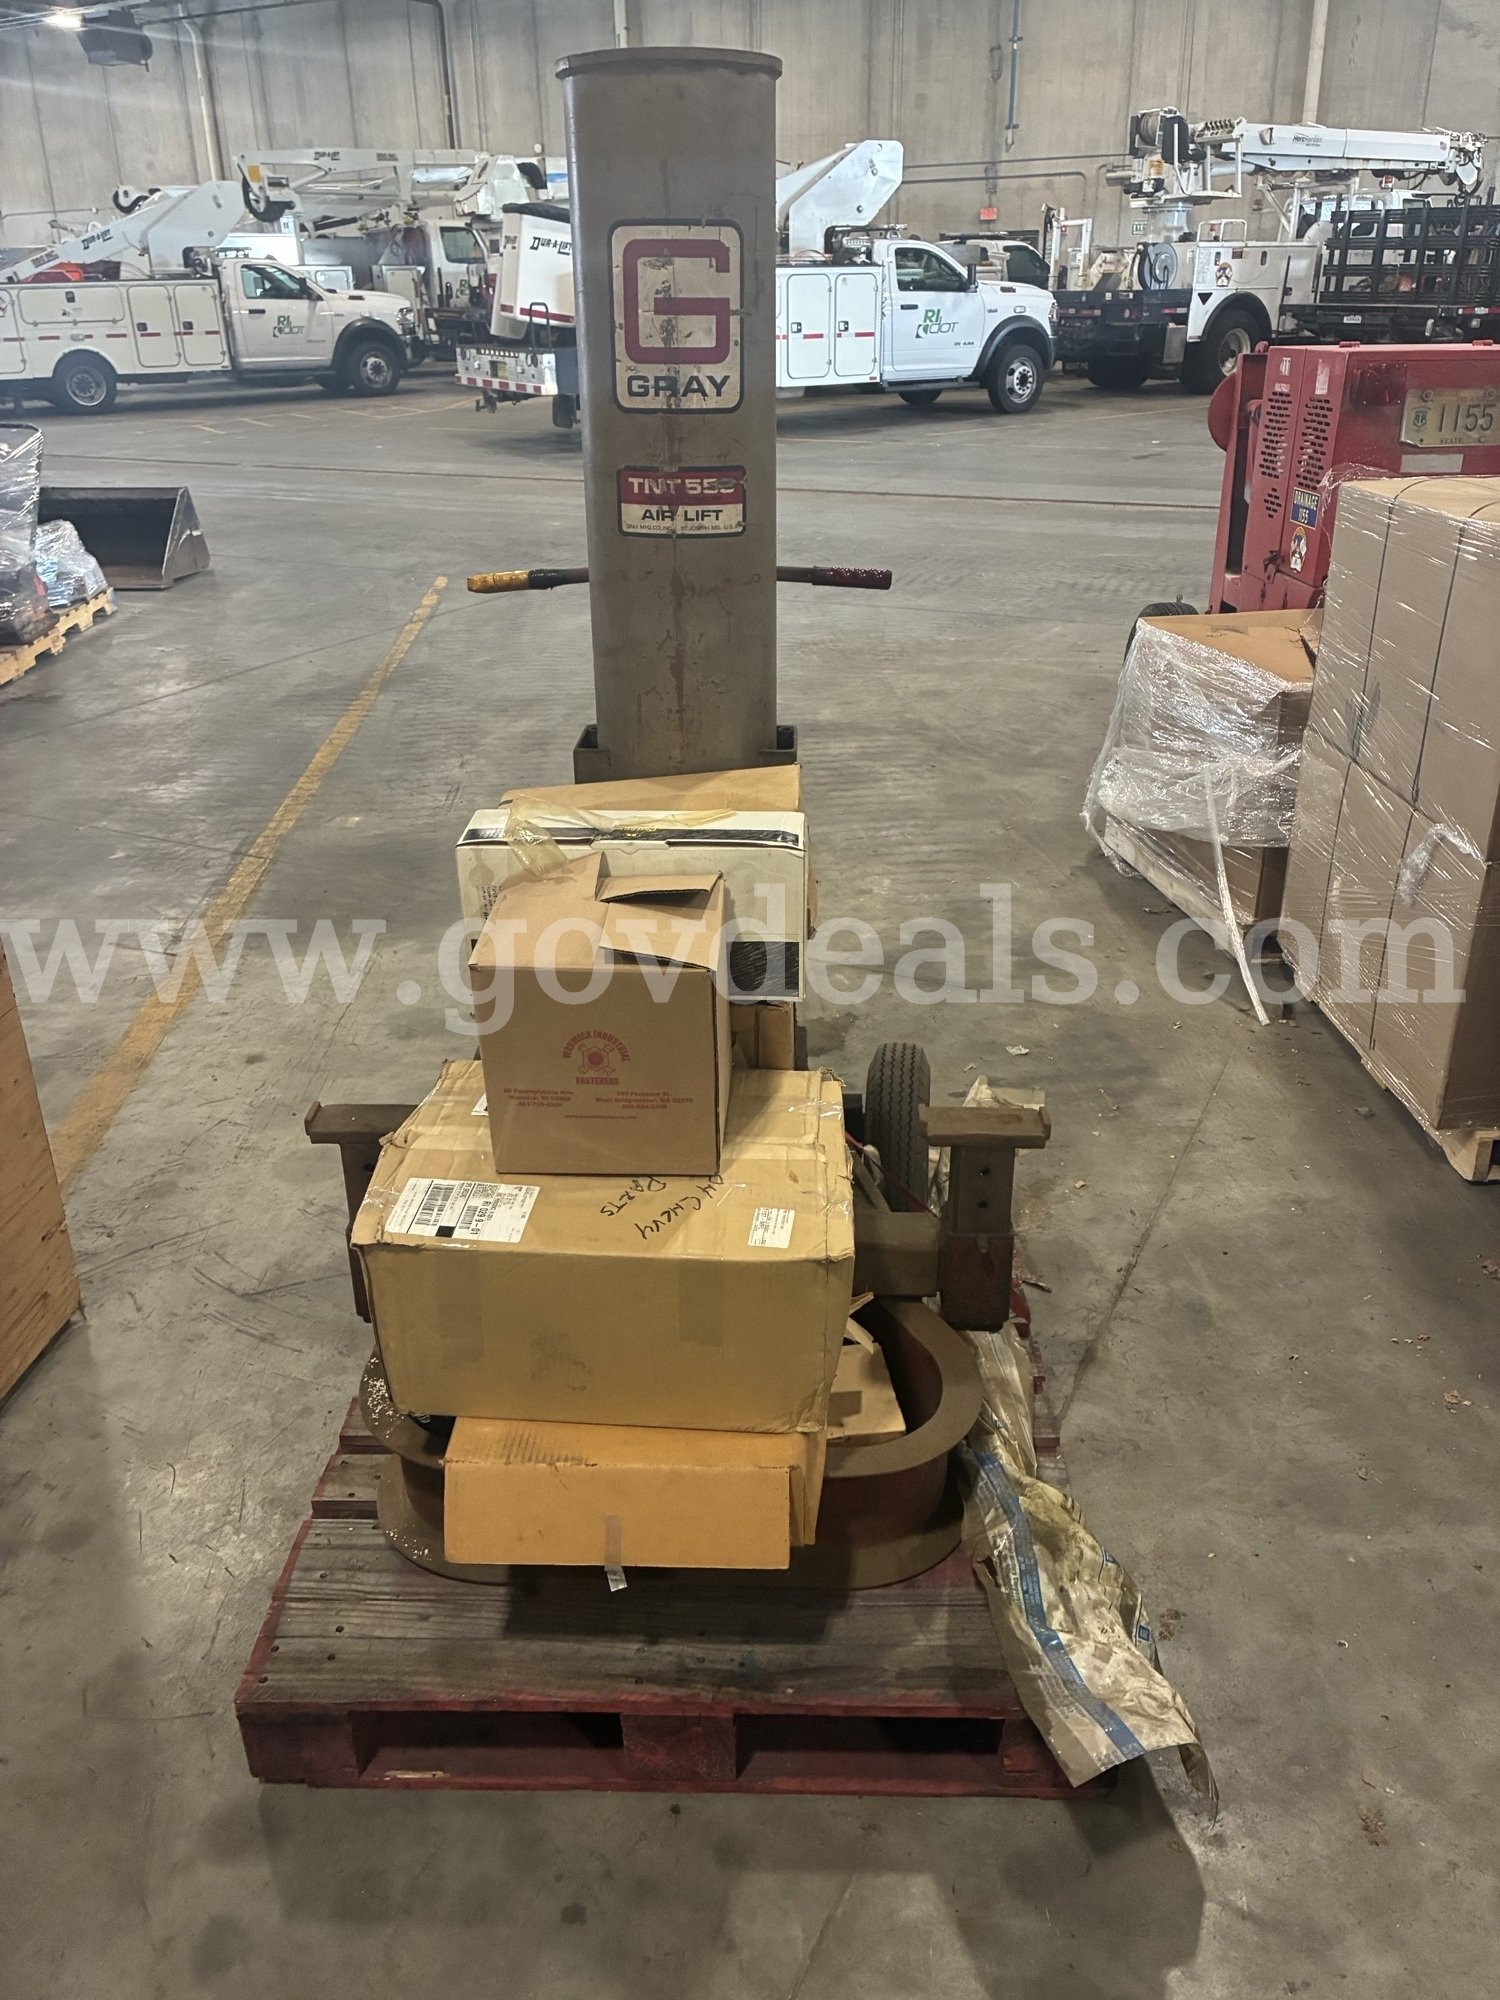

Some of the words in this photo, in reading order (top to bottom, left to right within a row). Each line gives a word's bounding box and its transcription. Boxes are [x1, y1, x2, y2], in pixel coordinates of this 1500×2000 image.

[623, 239, 730, 364] G
[277, 314, 290, 326] RI
[923, 308, 941, 323] RI
[627, 374, 731, 397] GRAY
[1438, 403, 1498, 433] 1155
[628, 477, 681, 495] TNT
[1294, 489, 1319, 511] DRAINAGE
[641, 509, 676, 521] AIR
[684, 509, 724, 521] LIFT
[593, 1030, 631, 1063] INDUSTRIAL
[575, 1076, 620, 1086] FASTENERS
[600, 1175, 667, 1217] PARTS
